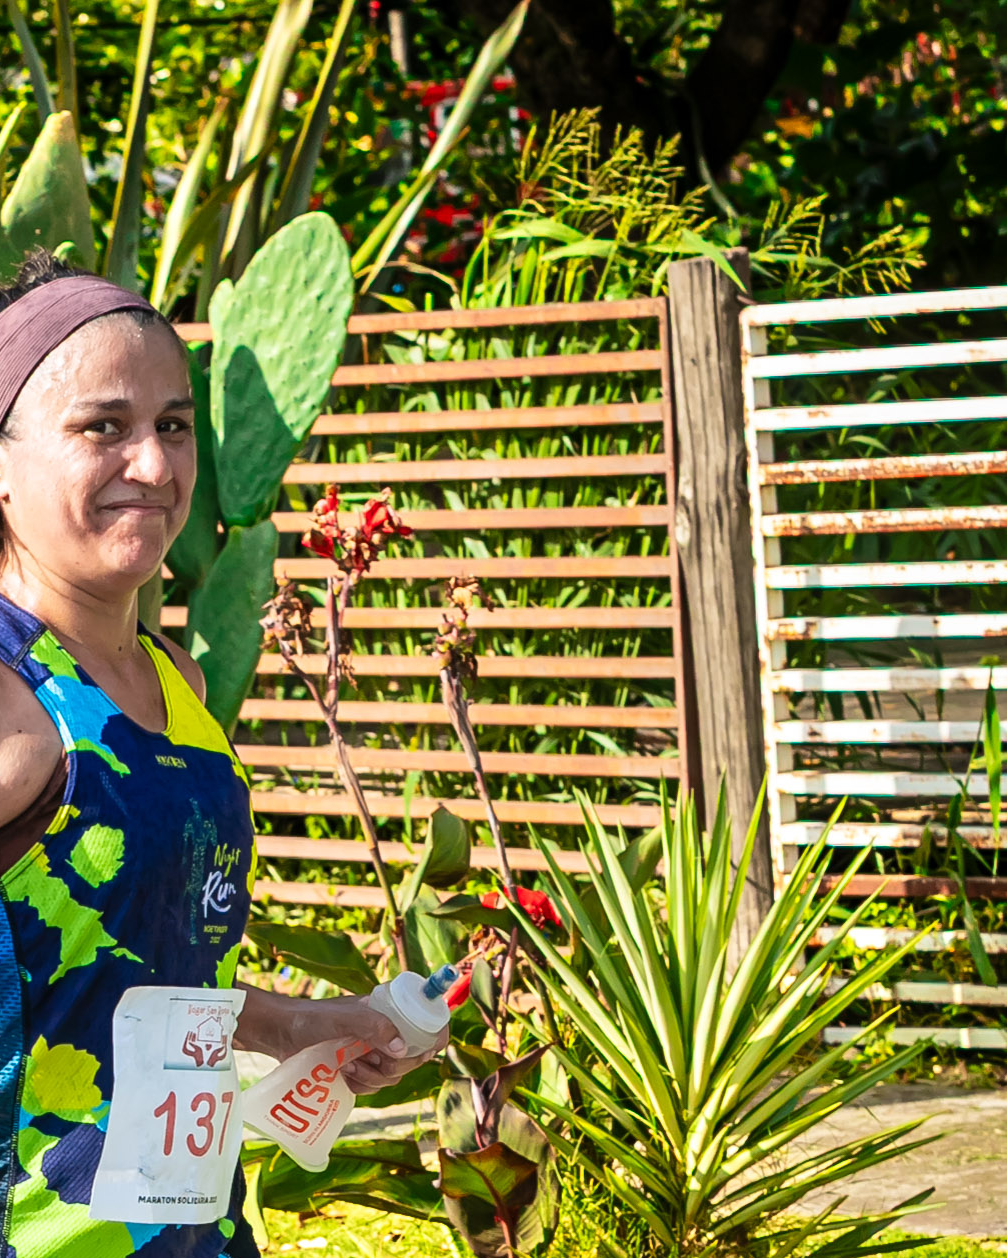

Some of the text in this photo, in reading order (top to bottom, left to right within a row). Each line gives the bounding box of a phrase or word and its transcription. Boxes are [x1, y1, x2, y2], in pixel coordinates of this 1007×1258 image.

[201, 870, 237, 918] Run
[154, 1091, 234, 1157] 137
[137, 1196, 176, 1204] MARATON
